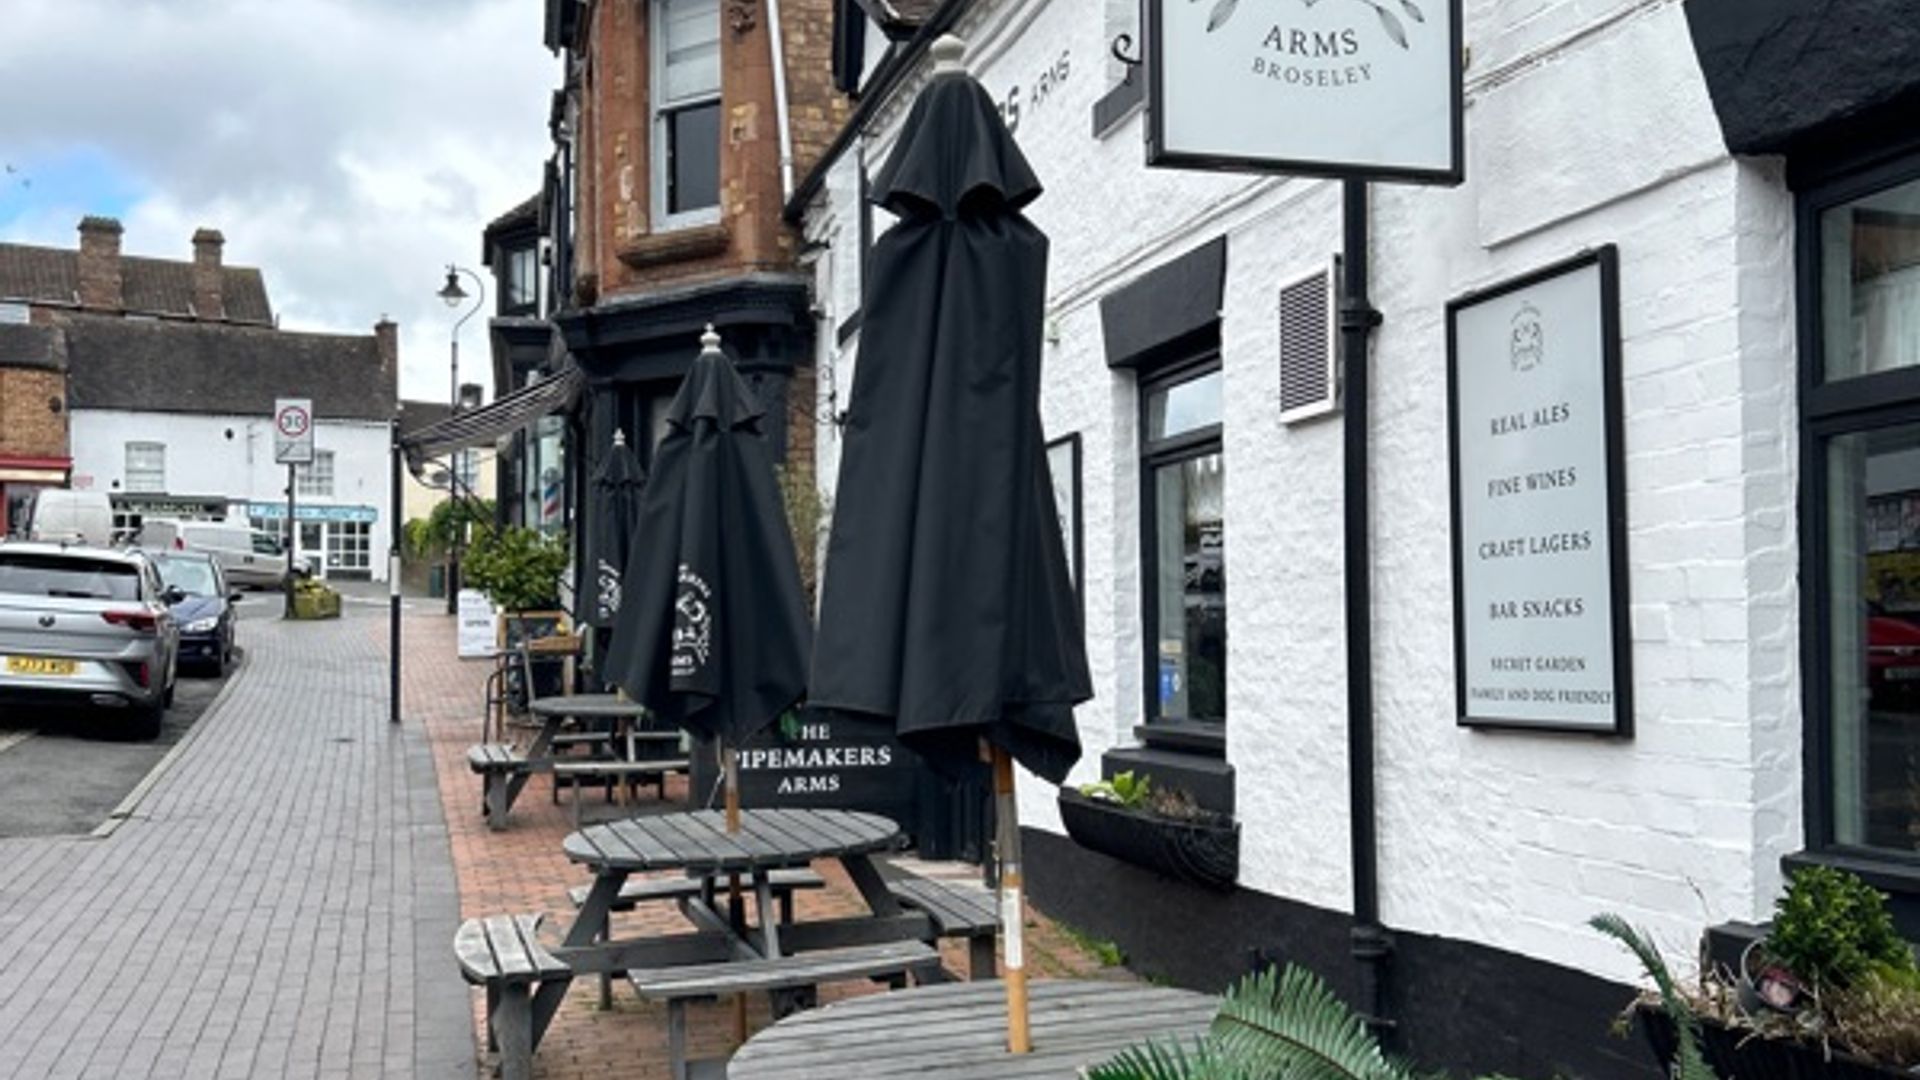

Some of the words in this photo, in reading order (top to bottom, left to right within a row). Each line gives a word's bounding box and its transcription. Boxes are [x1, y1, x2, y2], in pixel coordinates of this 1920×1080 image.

[1262, 25, 1359, 57] ARMS
[1031, 50, 1069, 112] ARMS
[1252, 57, 1372, 87] BROSELEY
[1490, 412, 1527, 436] REAL
[1533, 402, 1570, 428] ALES
[1488, 475, 1521, 498] FINE
[1527, 466, 1576, 490] WINES
[1478, 537, 1525, 560] CRAFT
[1530, 530, 1592, 555] LAGERS
[1490, 602, 1518, 620] BAR
[1523, 598, 1584, 617] SNACKS
[1491, 657, 1531, 671] SECRET
[1536, 657, 1586, 672] GARDEN
[1533, 689, 1555, 701] DOG
[1559, 689, 1612, 704] FRIENDLY
[792, 724, 831, 740] HE
[777, 774, 840, 793] ARMS
